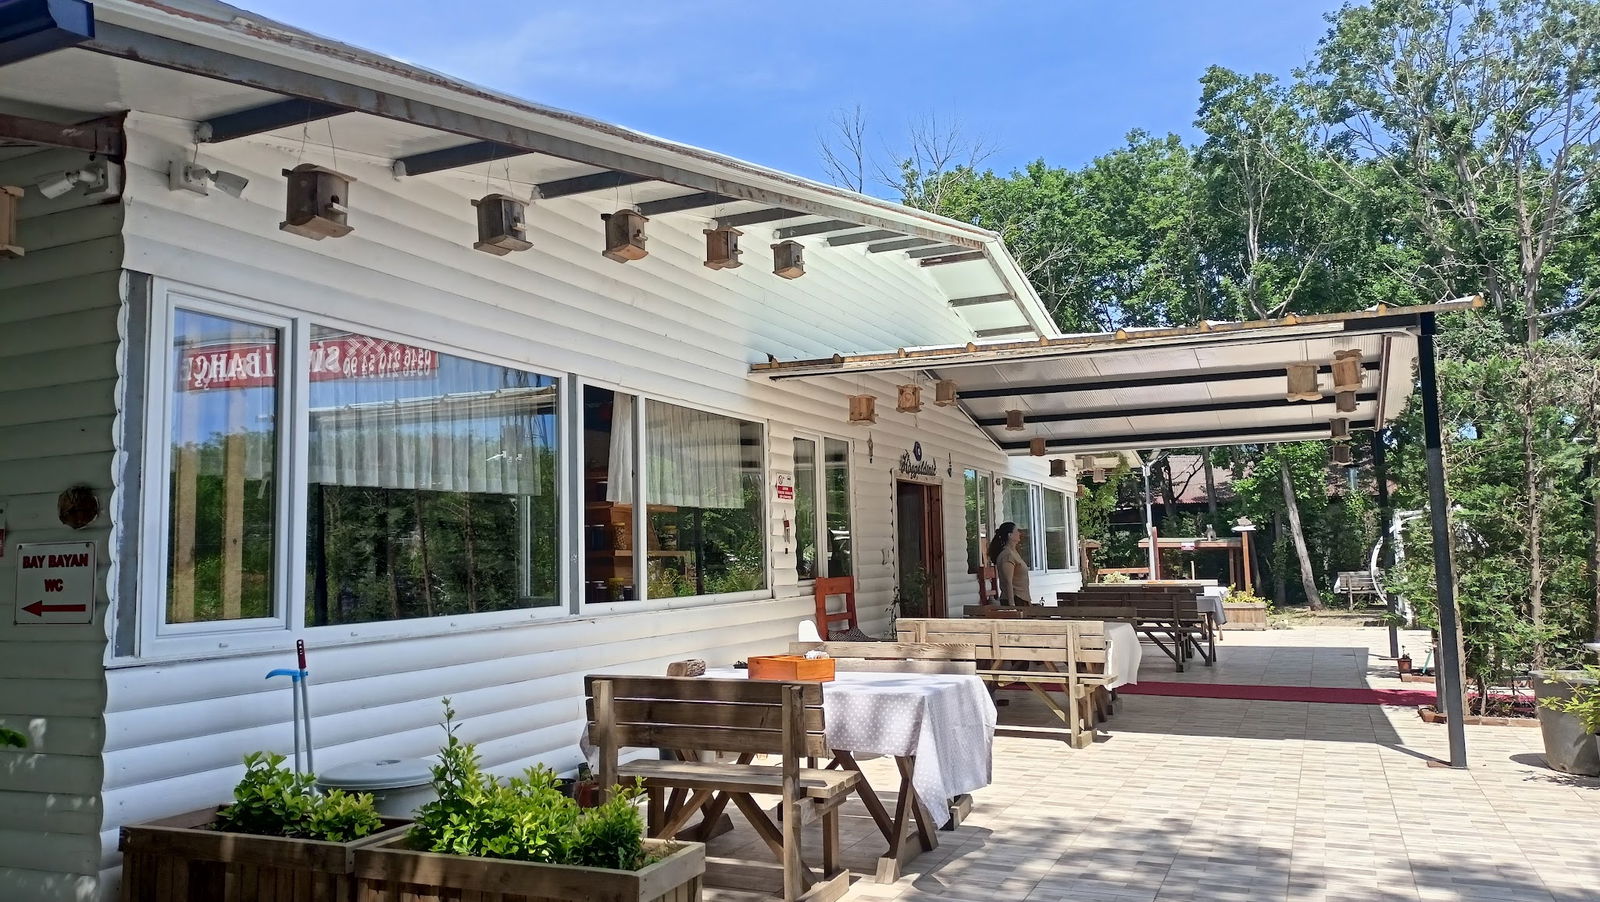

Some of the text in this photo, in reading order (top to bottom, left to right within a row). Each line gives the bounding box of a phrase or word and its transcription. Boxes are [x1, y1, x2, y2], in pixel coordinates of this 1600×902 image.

[22, 553, 89, 569] BAY BAYAN
[44, 578, 64, 592] WC
